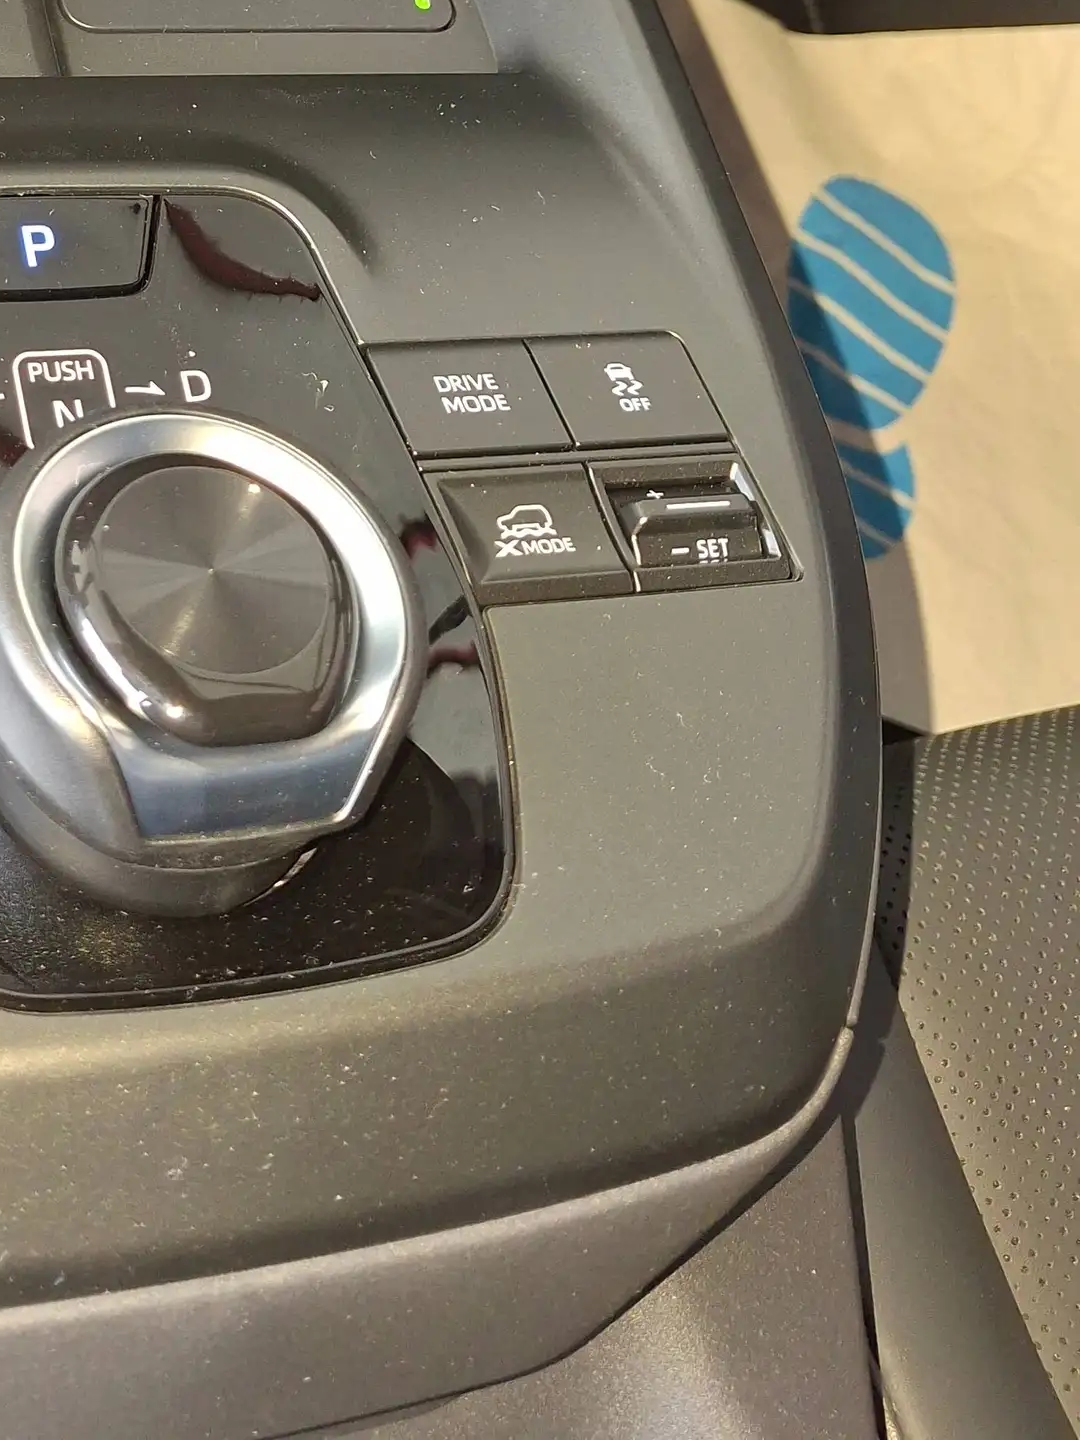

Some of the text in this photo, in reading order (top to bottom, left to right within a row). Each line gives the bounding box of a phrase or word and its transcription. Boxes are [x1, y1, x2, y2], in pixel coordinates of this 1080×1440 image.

[21, 224, 55, 267] P
[27, 360, 95, 383] PUSH
[180, 369, 212, 403] D
[433, 373, 499, 393] DRIVE
[441, 394, 511, 414] MODE
[620, 396, 652, 412] OFF
[696, 538, 729, 558] SET
